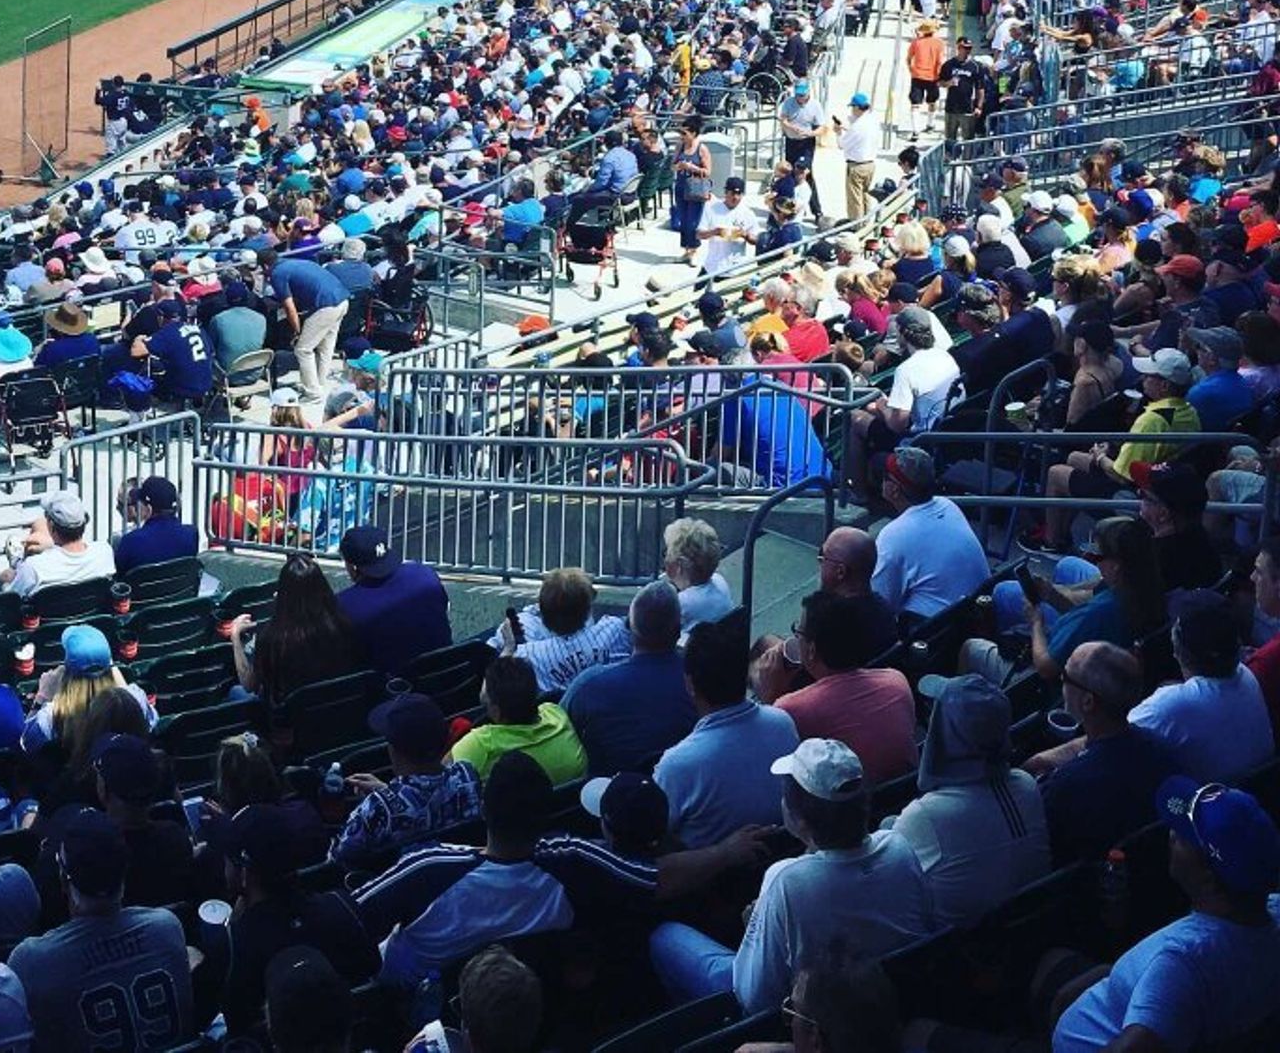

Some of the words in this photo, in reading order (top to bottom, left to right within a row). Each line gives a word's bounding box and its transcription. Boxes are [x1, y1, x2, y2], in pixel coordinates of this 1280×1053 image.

[134, 228, 157, 246] 99
[189, 334, 207, 362] 2
[78, 966, 182, 1053] 99
